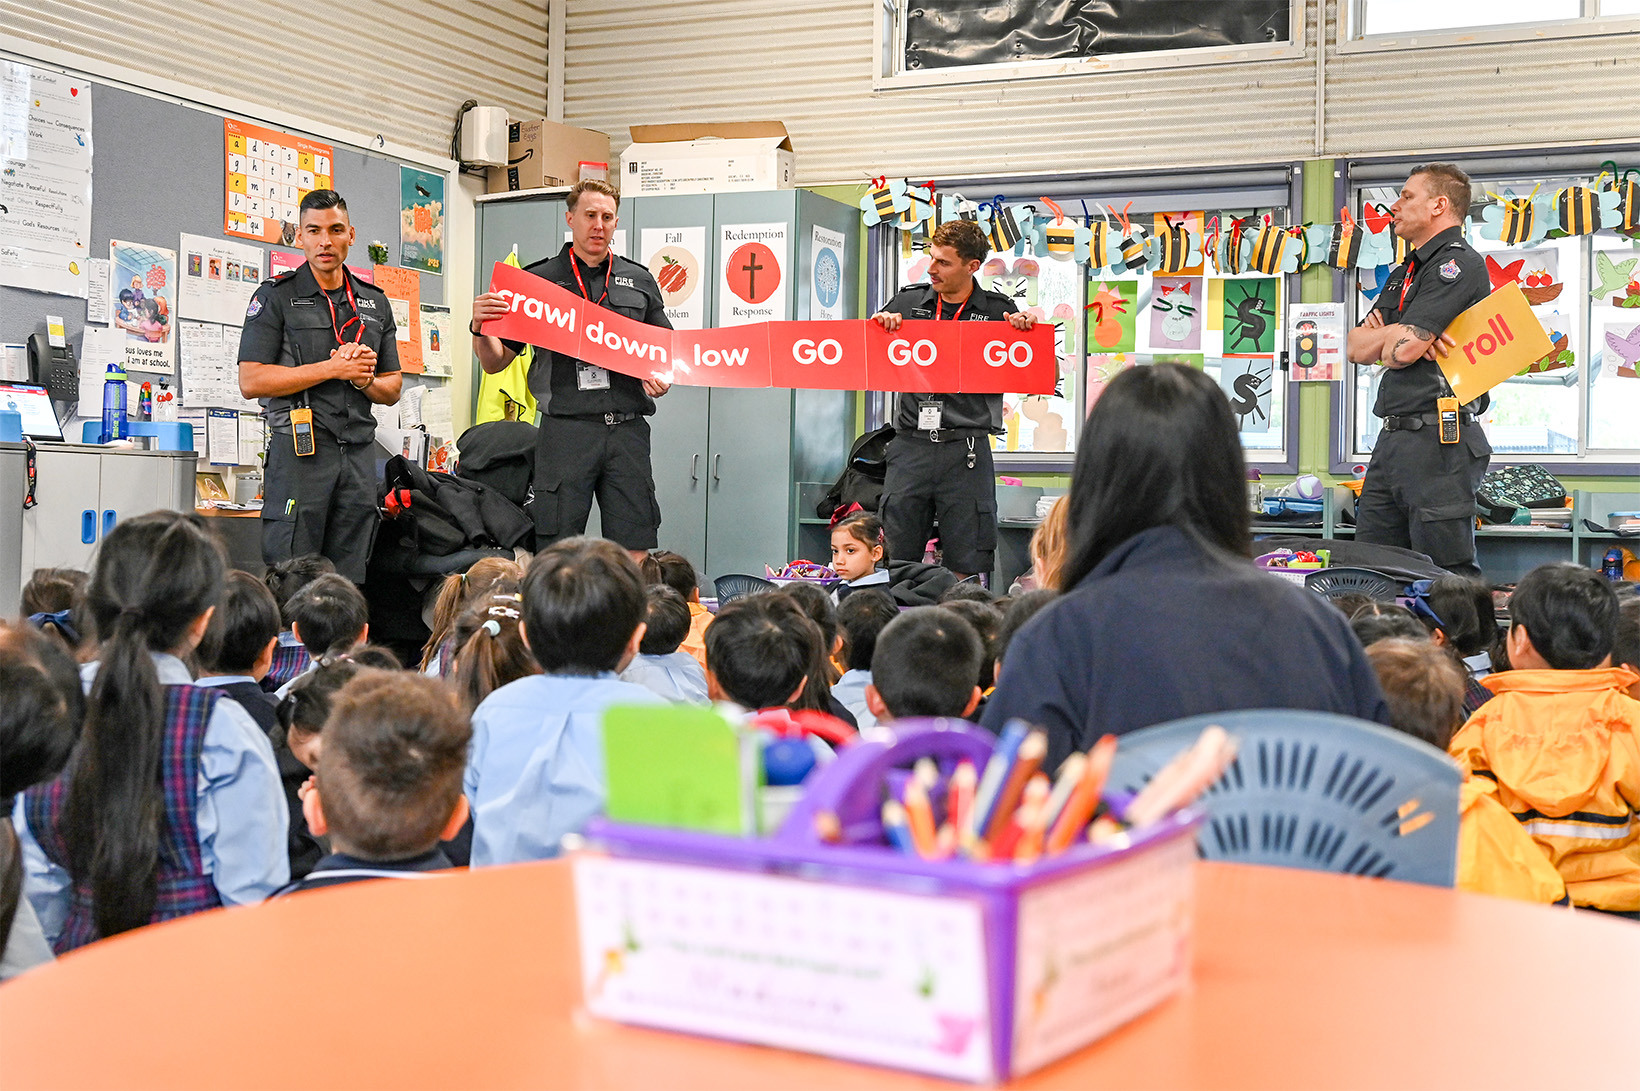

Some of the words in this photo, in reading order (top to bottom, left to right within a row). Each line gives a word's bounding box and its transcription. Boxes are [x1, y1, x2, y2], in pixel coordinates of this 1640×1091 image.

[28, 114, 46, 123] Choices
[55, 120, 85, 132] Consequences
[521, 124, 540, 133] Easter
[28, 130, 43, 138] Work
[523, 133, 537, 142] Eggs
[309, 145, 330, 155] Phonograms
[252, 141, 257, 152] d
[320, 157, 324, 173] f
[234, 160, 239, 172] g
[252, 159, 257, 171] h
[271, 167, 274, 175] t
[320, 177, 323, 187] i
[1, 178, 24, 188] Negotiate
[26, 182, 46, 192] Peaceful
[251, 183, 259, 191] m
[269, 188, 275, 199] p
[288, 187, 291, 198] l
[235, 194, 239, 205] b
[35, 200, 63, 213] Respectfully
[37, 222, 60, 231] Resources
[234, 220, 239, 230] y
[251, 222, 259, 234] qu
[665, 232, 682, 243] Fall
[725, 228, 784, 242] Redemption
[1, 248, 18, 259] Safety
[428, 258, 440, 268] 2025
[615, 277, 634, 285] FIRE
[732, 306, 773, 319] Response
[820, 309, 833, 320] Hope
[970, 313, 989, 321] FIRE
[499, 289, 576, 333] crawl
[585, 321, 667, 363] down
[694, 344, 749, 367] low
[792, 339, 842, 365] GO
[887, 339, 937, 366] GO
[983, 340, 1033, 367] GO
[1462, 314, 1514, 364] roll
[137, 347, 152, 356] loves
[150, 359, 170, 368] school.
